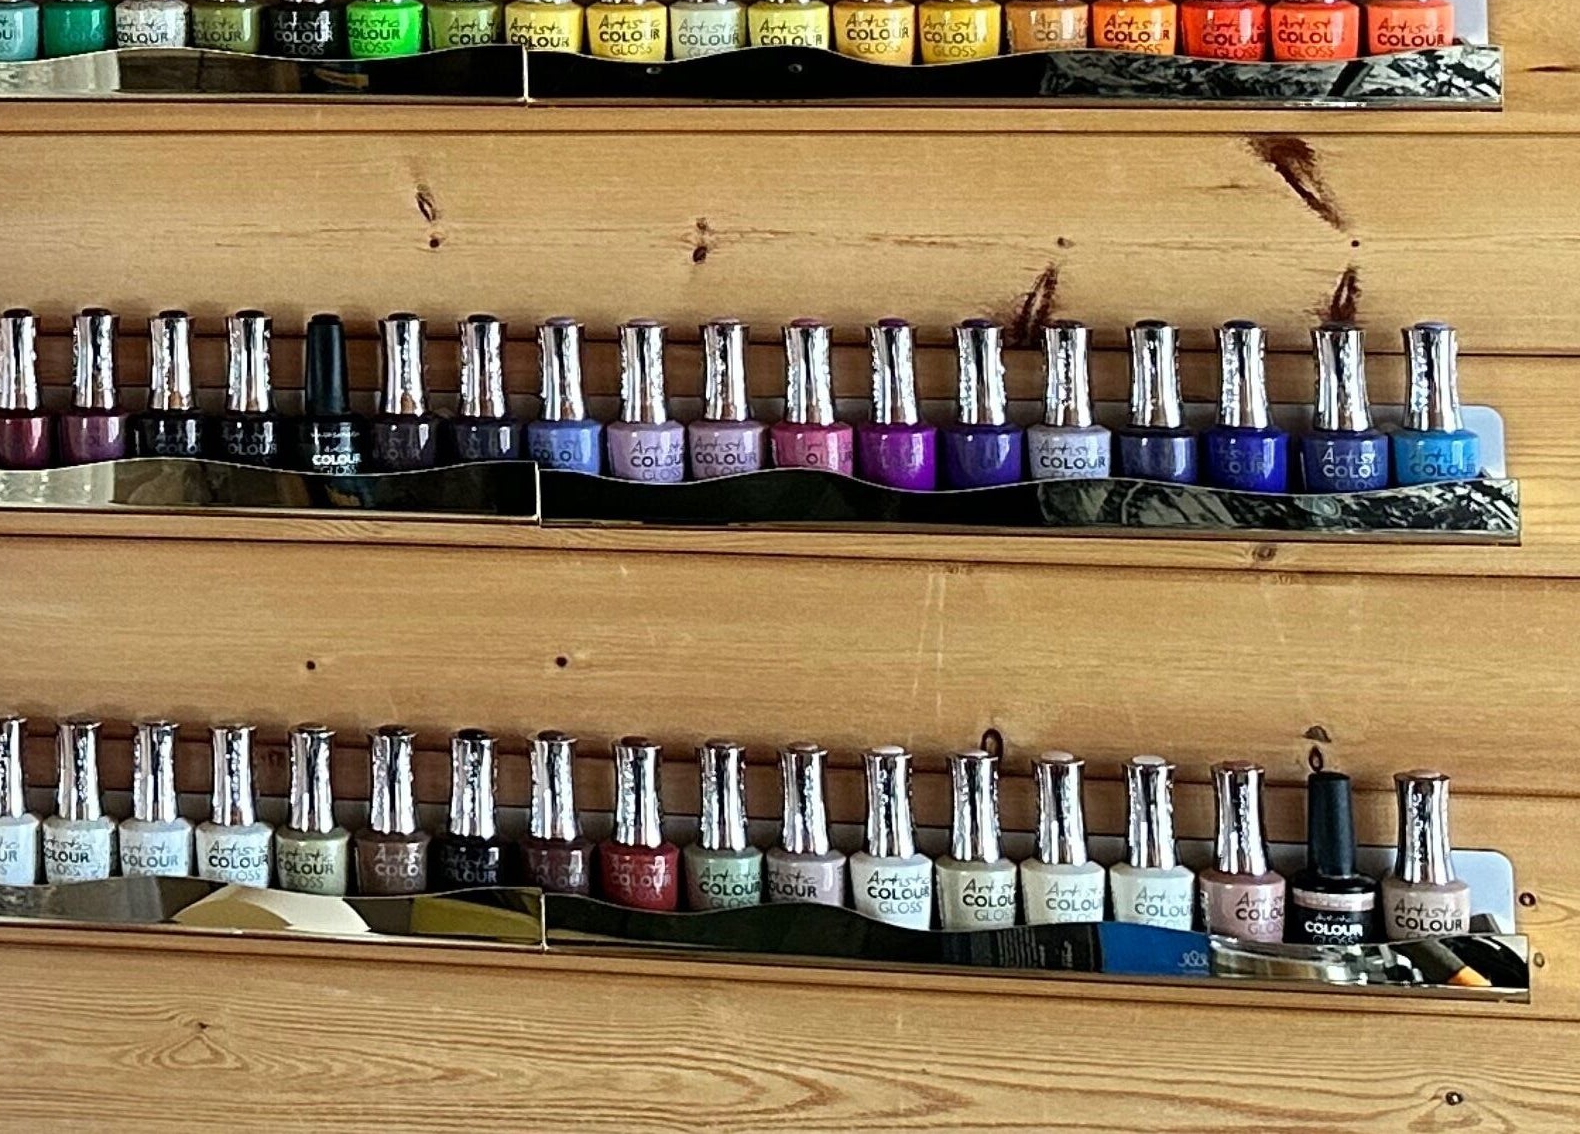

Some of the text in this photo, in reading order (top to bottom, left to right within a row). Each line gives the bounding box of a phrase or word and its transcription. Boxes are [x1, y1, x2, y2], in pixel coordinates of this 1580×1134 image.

[678, 19, 738, 32] Artistic
[117, 31, 168, 43] COLOUR
[275, 30, 332, 43] COLOUR
[348, 29, 400, 39] COLOUR
[599, 31, 661, 42] COLOUR
[678, 33, 740, 45] COLOUR
[847, 28, 909, 40] COLOUR
[1104, 30, 1169, 41] COLOUR
[1378, 33, 1444, 45] COLOUR
[353, 42, 390, 53] GLOSS
[611, 44, 651, 55] GLOSS
[856, 43, 900, 54] GLOSS
[932, 46, 976, 57] GLOSS
[1288, 46, 1334, 58] GLOSS
[312, 454, 361, 465] COLOUR
[695, 453, 756, 464] COLOUR
[1041, 457, 1105, 467] COLOUR
[123, 855, 178, 866] COLOUR
[868, 871, 929, 887] Artistic
[868, 887, 929, 899] COLOUR
[879, 902, 922, 913] GLOSS
[1395, 899, 1461, 916] Artistic
[1306, 922, 1362, 936] COLOUR
[1396, 917, 1462, 930] COLOUR
